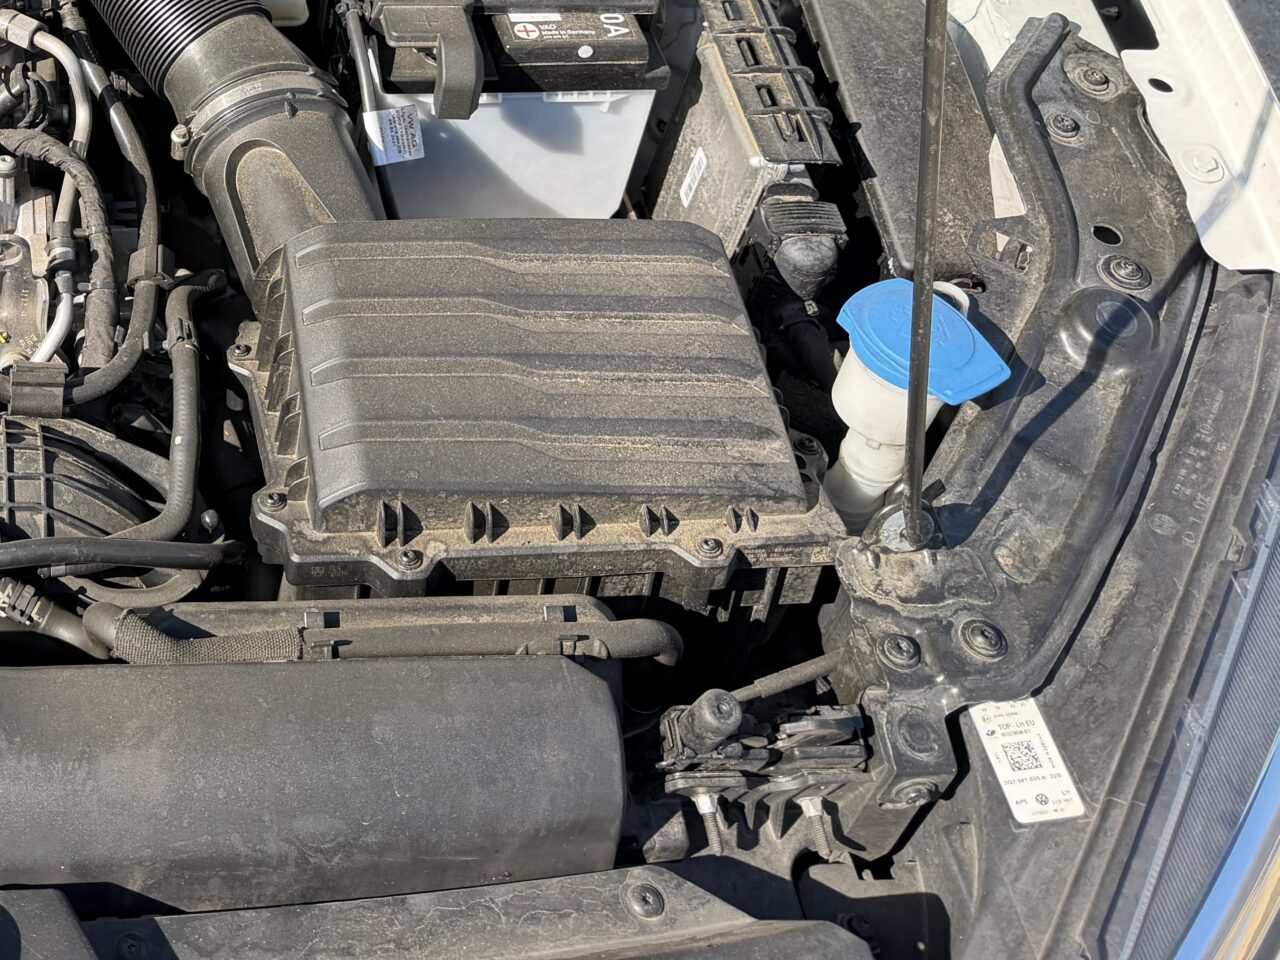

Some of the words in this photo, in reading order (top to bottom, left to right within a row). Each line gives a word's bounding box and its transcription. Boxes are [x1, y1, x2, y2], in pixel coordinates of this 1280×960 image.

[407, 113, 415, 130] VW
[410, 133, 418, 148] AG
[998, 722, 1011, 731] TOP
[1025, 719, 1035, 727] EU
